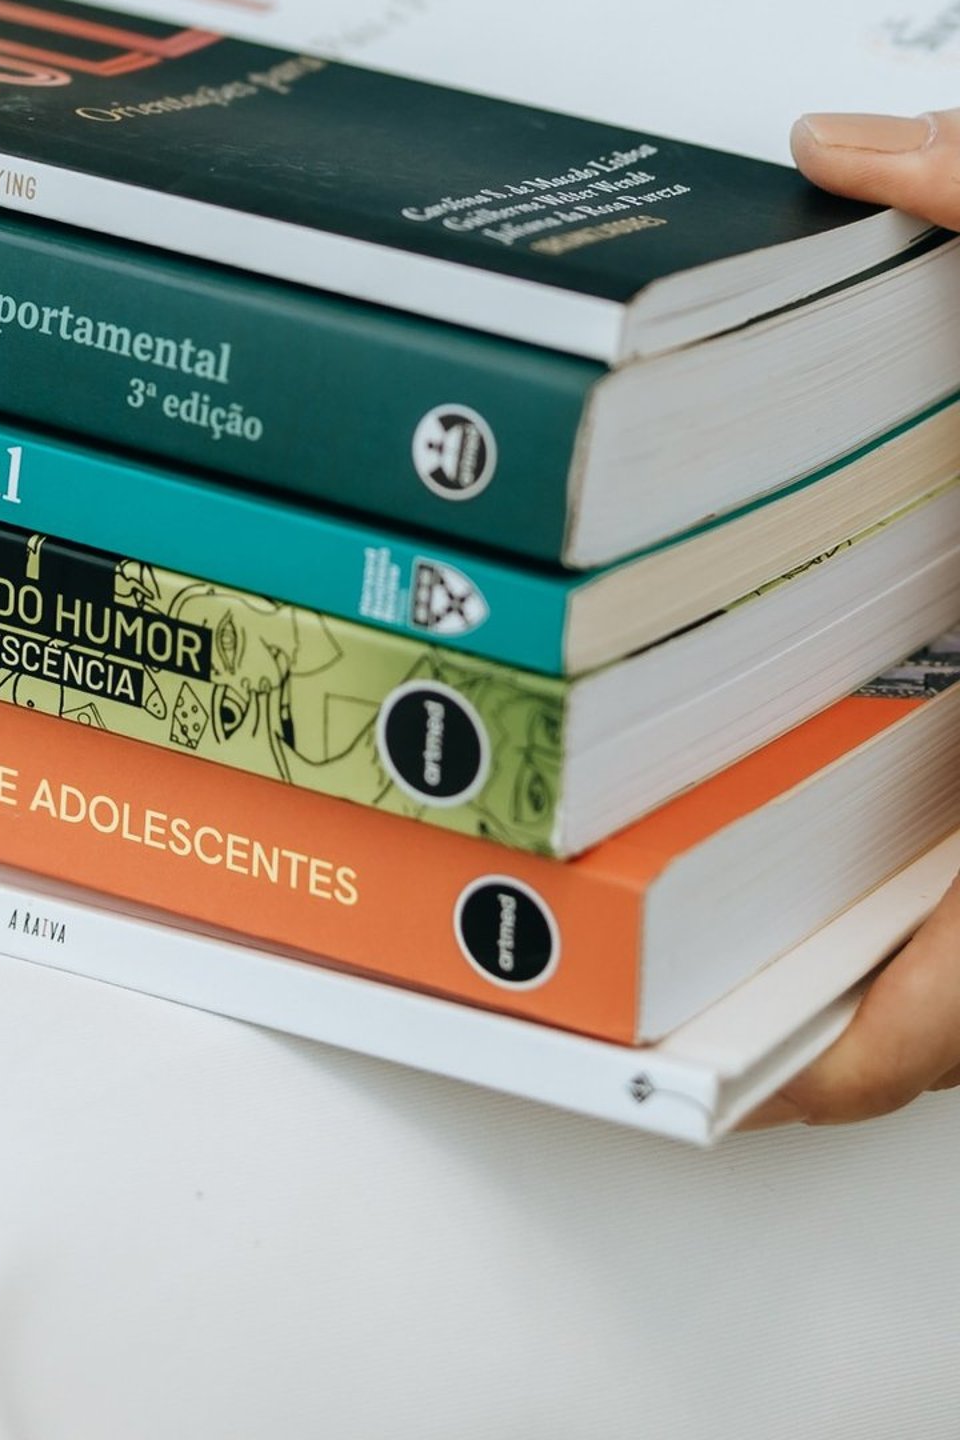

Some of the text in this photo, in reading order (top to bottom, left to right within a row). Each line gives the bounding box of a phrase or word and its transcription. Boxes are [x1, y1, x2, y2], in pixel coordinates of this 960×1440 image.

[504, 184, 535, 196] de
[522, 167, 600, 191] Macedo
[532, 189, 599, 206] Welter
[587, 170, 656, 193] Wendt
[617, 184, 691, 206] Pureza
[127, 376, 264, 442] 3ª edição
[55, 599, 204, 673] HUMOR
[423, 698, 446, 787] artmed
[30, 778, 359, 907] ADOLESCENTES
[8, 908, 67, 944] A RAIVA
[498, 893, 518, 973] artmed
